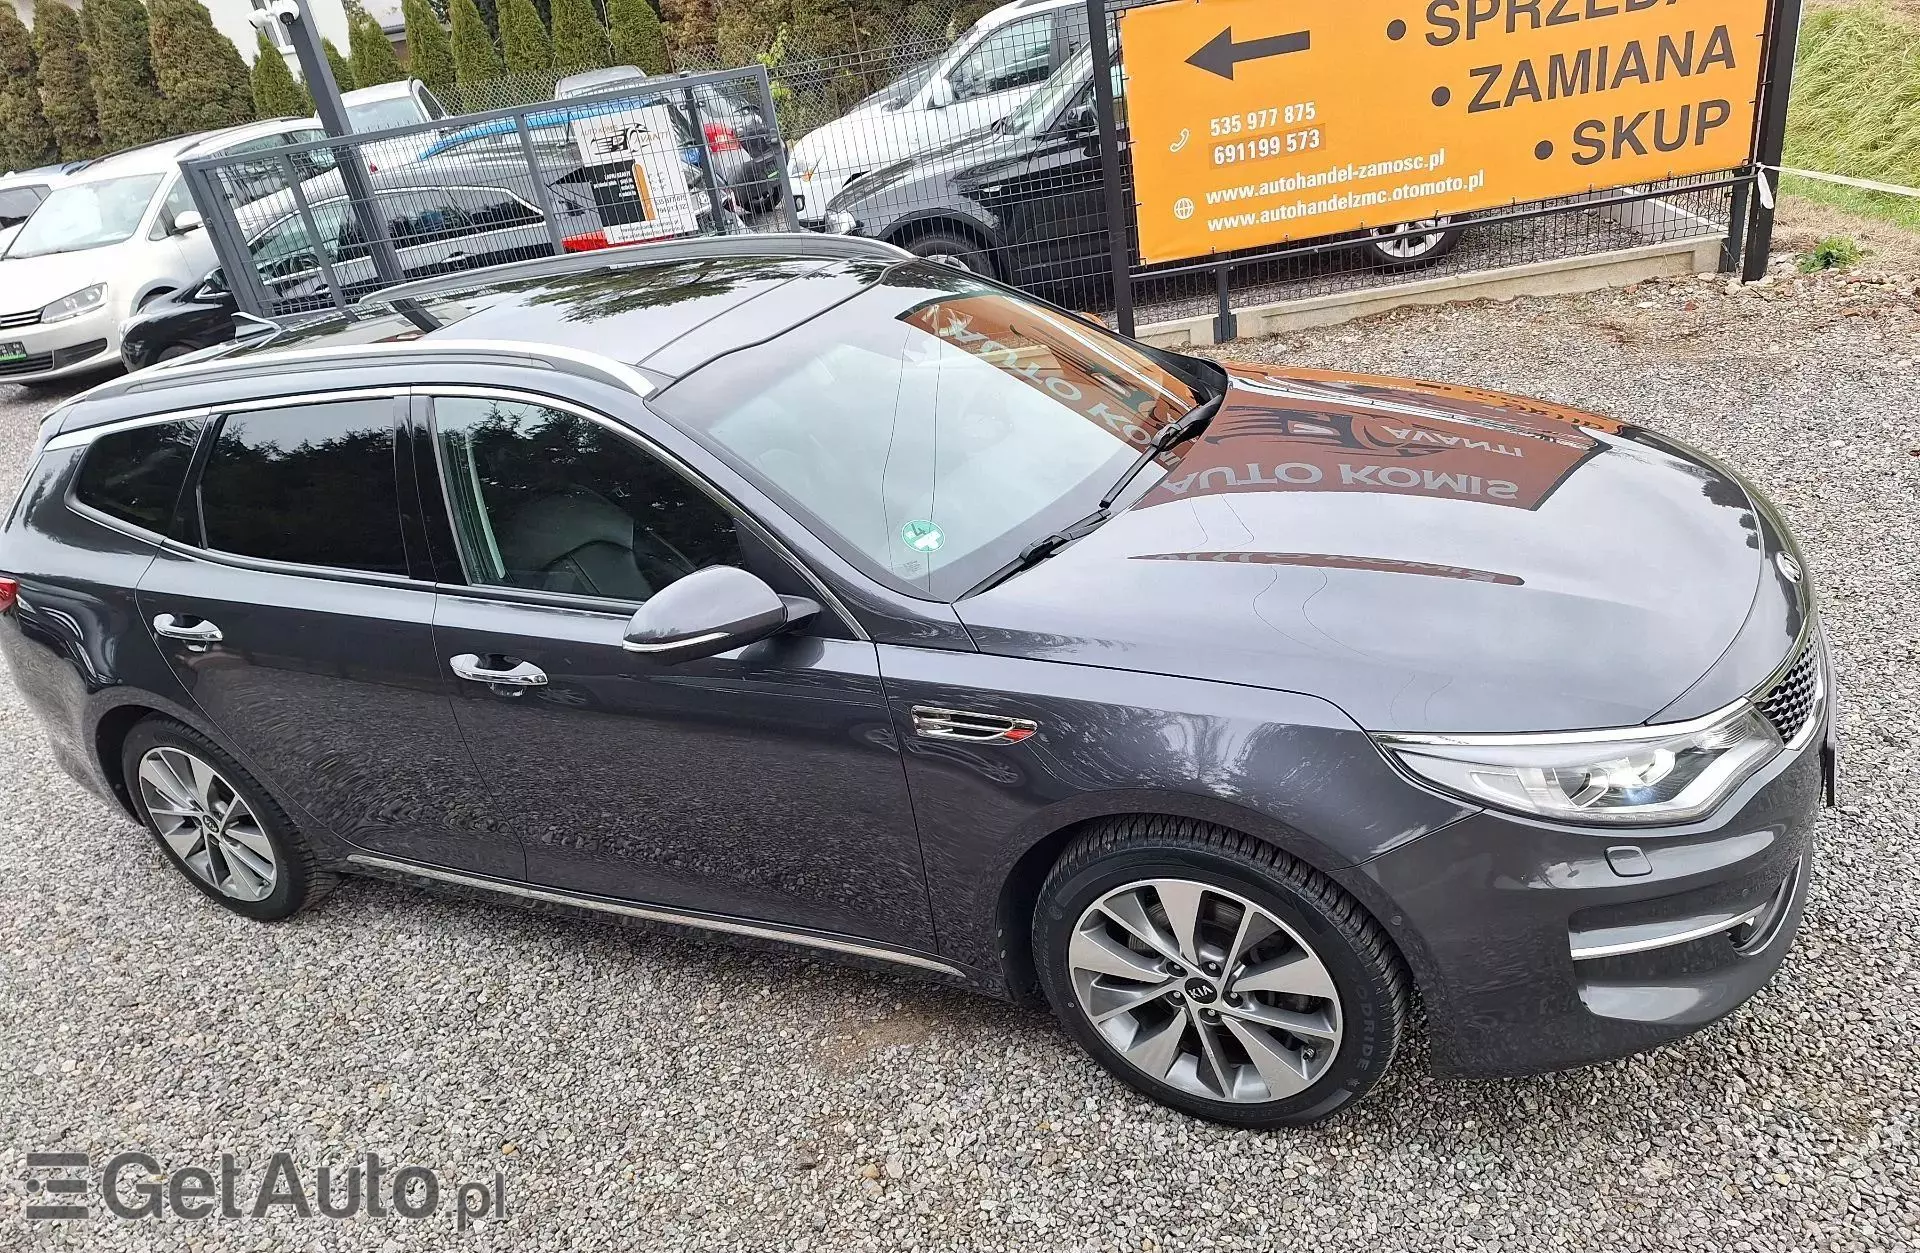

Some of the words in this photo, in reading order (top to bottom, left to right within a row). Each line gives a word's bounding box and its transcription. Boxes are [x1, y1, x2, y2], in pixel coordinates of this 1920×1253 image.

[1425, 0, 1681, 47] SPRZ
[1467, 25, 1736, 114] ZAMIANA
[1210, 115, 1241, 137] 535
[1247, 108, 1278, 131] 977
[1284, 101, 1316, 124] 875
[1286, 129, 1320, 151] 573
[1571, 99, 1731, 166] SKUP
[1206, 148, 1445, 205] www.autohandel-zamosc.pl
[1207, 171, 1485, 232] www.autohandelzmc.otomoto.pl
